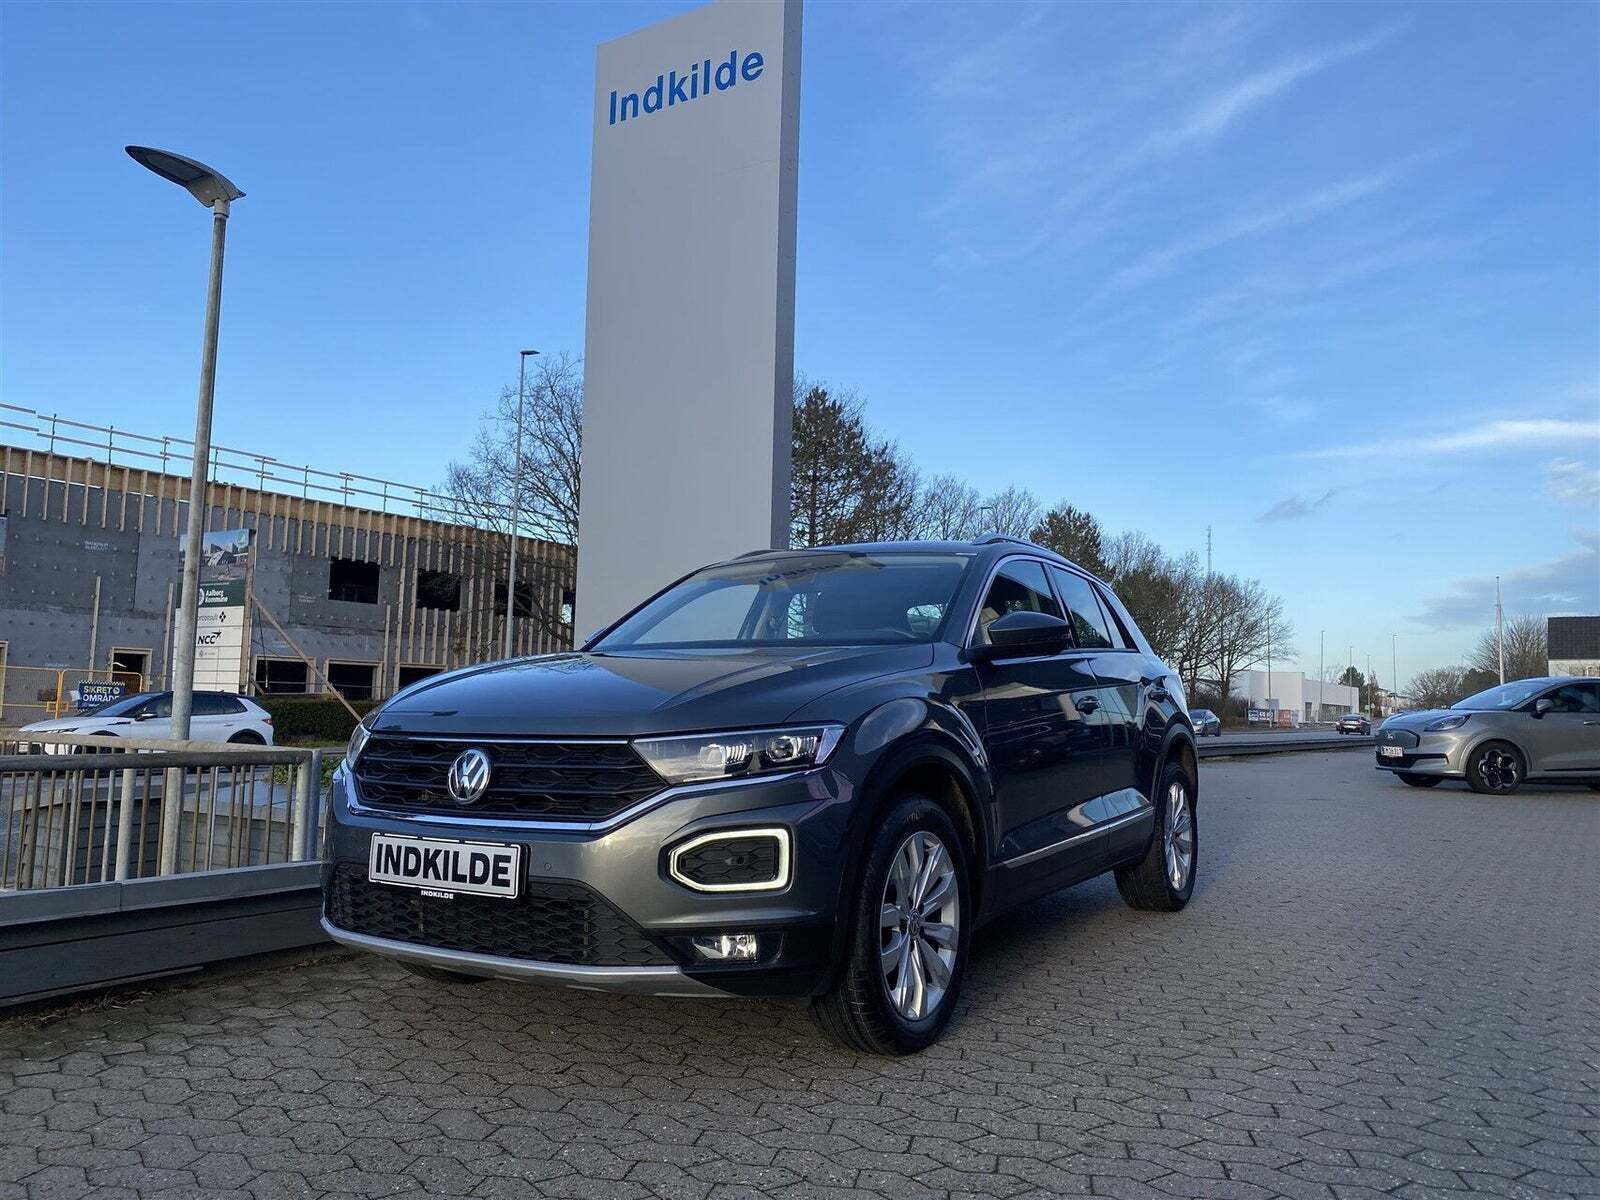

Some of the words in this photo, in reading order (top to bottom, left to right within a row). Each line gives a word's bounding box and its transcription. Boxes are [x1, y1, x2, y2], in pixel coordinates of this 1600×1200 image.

[609, 50, 764, 125] Indkilde
[197, 635, 216, 645] NCC
[83, 685, 112, 694] SIKRET
[375, 843, 512, 888] INDKILDE
[420, 889, 454, 899] INDKILDE
